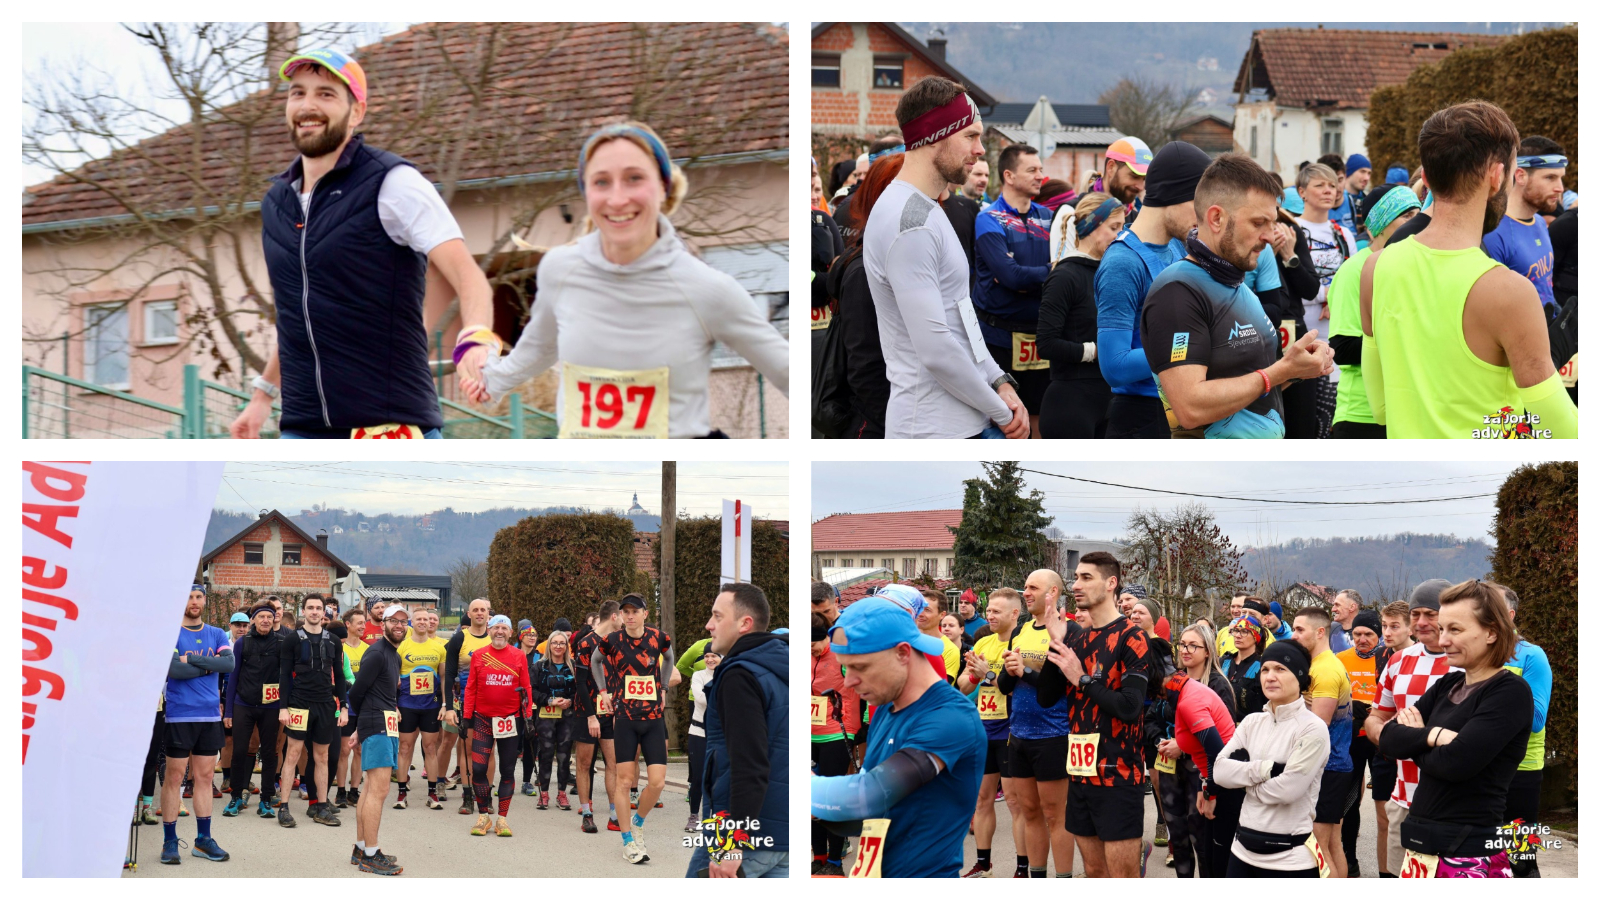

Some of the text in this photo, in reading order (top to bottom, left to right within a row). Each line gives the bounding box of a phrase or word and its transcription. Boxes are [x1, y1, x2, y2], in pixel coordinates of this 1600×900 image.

[577, 381, 656, 430] 197
[22, 461, 92, 766] gorje Ad
[415, 678, 429, 690] 54
[627, 680, 654, 695] 636
[980, 695, 998, 712] 54
[497, 719, 513, 733] 98
[1070, 742, 1096, 767] 618
